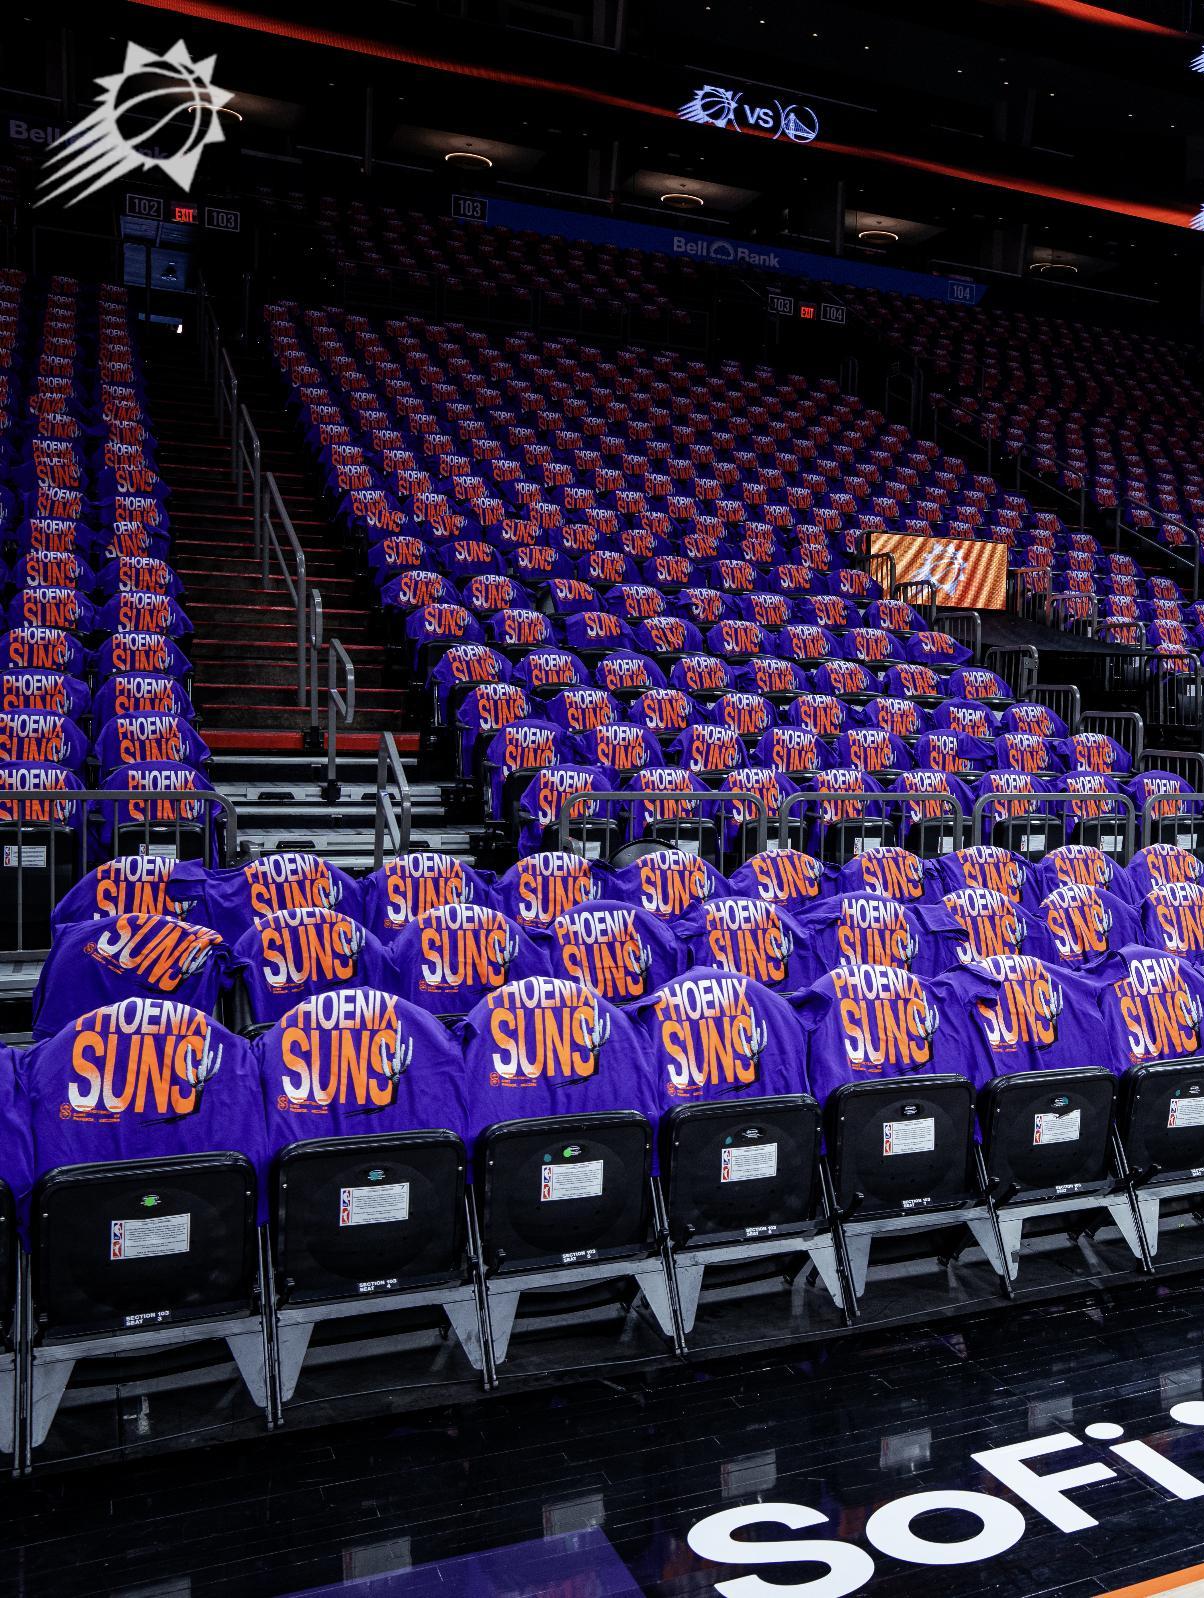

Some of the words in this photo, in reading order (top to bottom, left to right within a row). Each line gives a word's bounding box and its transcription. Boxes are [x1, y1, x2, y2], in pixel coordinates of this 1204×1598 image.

[744, 105, 774, 128] VS
[133, 199, 158, 216] 102
[176, 207, 193, 222] EXIT
[211, 211, 235, 228] 103
[458, 200, 482, 218] 103
[673, 236, 708, 258] Bell
[737, 247, 780, 269] Bank
[774, 296, 791, 312] 103
[953, 284, 971, 300] 104
[800, 304, 814, 320] EXIT
[824, 305, 842, 321] 104
[10, 628, 66, 645] PHOENIX
[112, 634, 166, 650] PHOENIX
[530, 655, 573, 670] PHOENIX
[603, 658, 645, 675] PHOENIX
[4, 674, 65, 696] PHOENIX
[116, 678, 174, 696] PHOENIX
[564, 692, 609, 708] PHOENIX
[644, 700, 687, 728] SUNS
[117, 717, 180, 740] PHOENIX
[506, 727, 556, 749] PHOENIX
[597, 726, 644, 747] PHOENIX
[692, 724, 738, 745] PHOENIX
[772, 729, 817, 750] PHOENIX
[848, 730, 891, 748] PHOENIX
[1004, 733, 1044, 750] PHOENIX
[692, 742, 738, 772] SUNS
[128, 770, 196, 791] PHOENIX
[540, 769, 594, 792] PHOENIX
[818, 770, 862, 790] PHOENIX
[904, 772, 948, 792] PHOENIX
[96, 856, 180, 882] PHOENI
[244, 853, 328, 884] PHOENIX
[385, 852, 462, 878] PHOENIX
[518, 851, 591, 876] PHOENIX
[862, 854, 924, 900] SUNS
[640, 868, 705, 914] SUNS
[752, 854, 819, 902] SUNS
[251, 877, 331, 924] SUNS
[387, 875, 463, 924] SUNS
[518, 874, 591, 922] SUNS
[944, 888, 1010, 916] PHOENIX
[417, 903, 508, 930] PHOENIX
[554, 910, 637, 945] PHOENIX
[704, 900, 780, 932] PHOENIX
[1048, 904, 1107, 954] SUNS
[97, 912, 212, 992] SUNS
[261, 922, 354, 987] SUNS
[420, 928, 506, 987] SUNS
[708, 928, 786, 982] SUNS
[838, 925, 912, 968] SUNS
[562, 940, 644, 999] SUNS
[831, 964, 925, 1002] PHOENIX
[488, 976, 597, 1008] PHOENIX
[654, 978, 749, 1021] PHOENIX
[76, 998, 208, 1034] PHOENIX
[282, 990, 400, 1030] PHOENIX
[977, 976, 1057, 1046] SUNS
[1120, 990, 1199, 1057] SUNS
[490, 1006, 599, 1079] SUNS
[840, 998, 931, 1066] SUNS
[662, 1014, 758, 1090] SUNS
[68, 1030, 204, 1115] SUNS
[282, 1026, 398, 1107] SUNS
[359, 1280, 385, 1288] SECTION
[126, 1312, 156, 1322] SECTION
